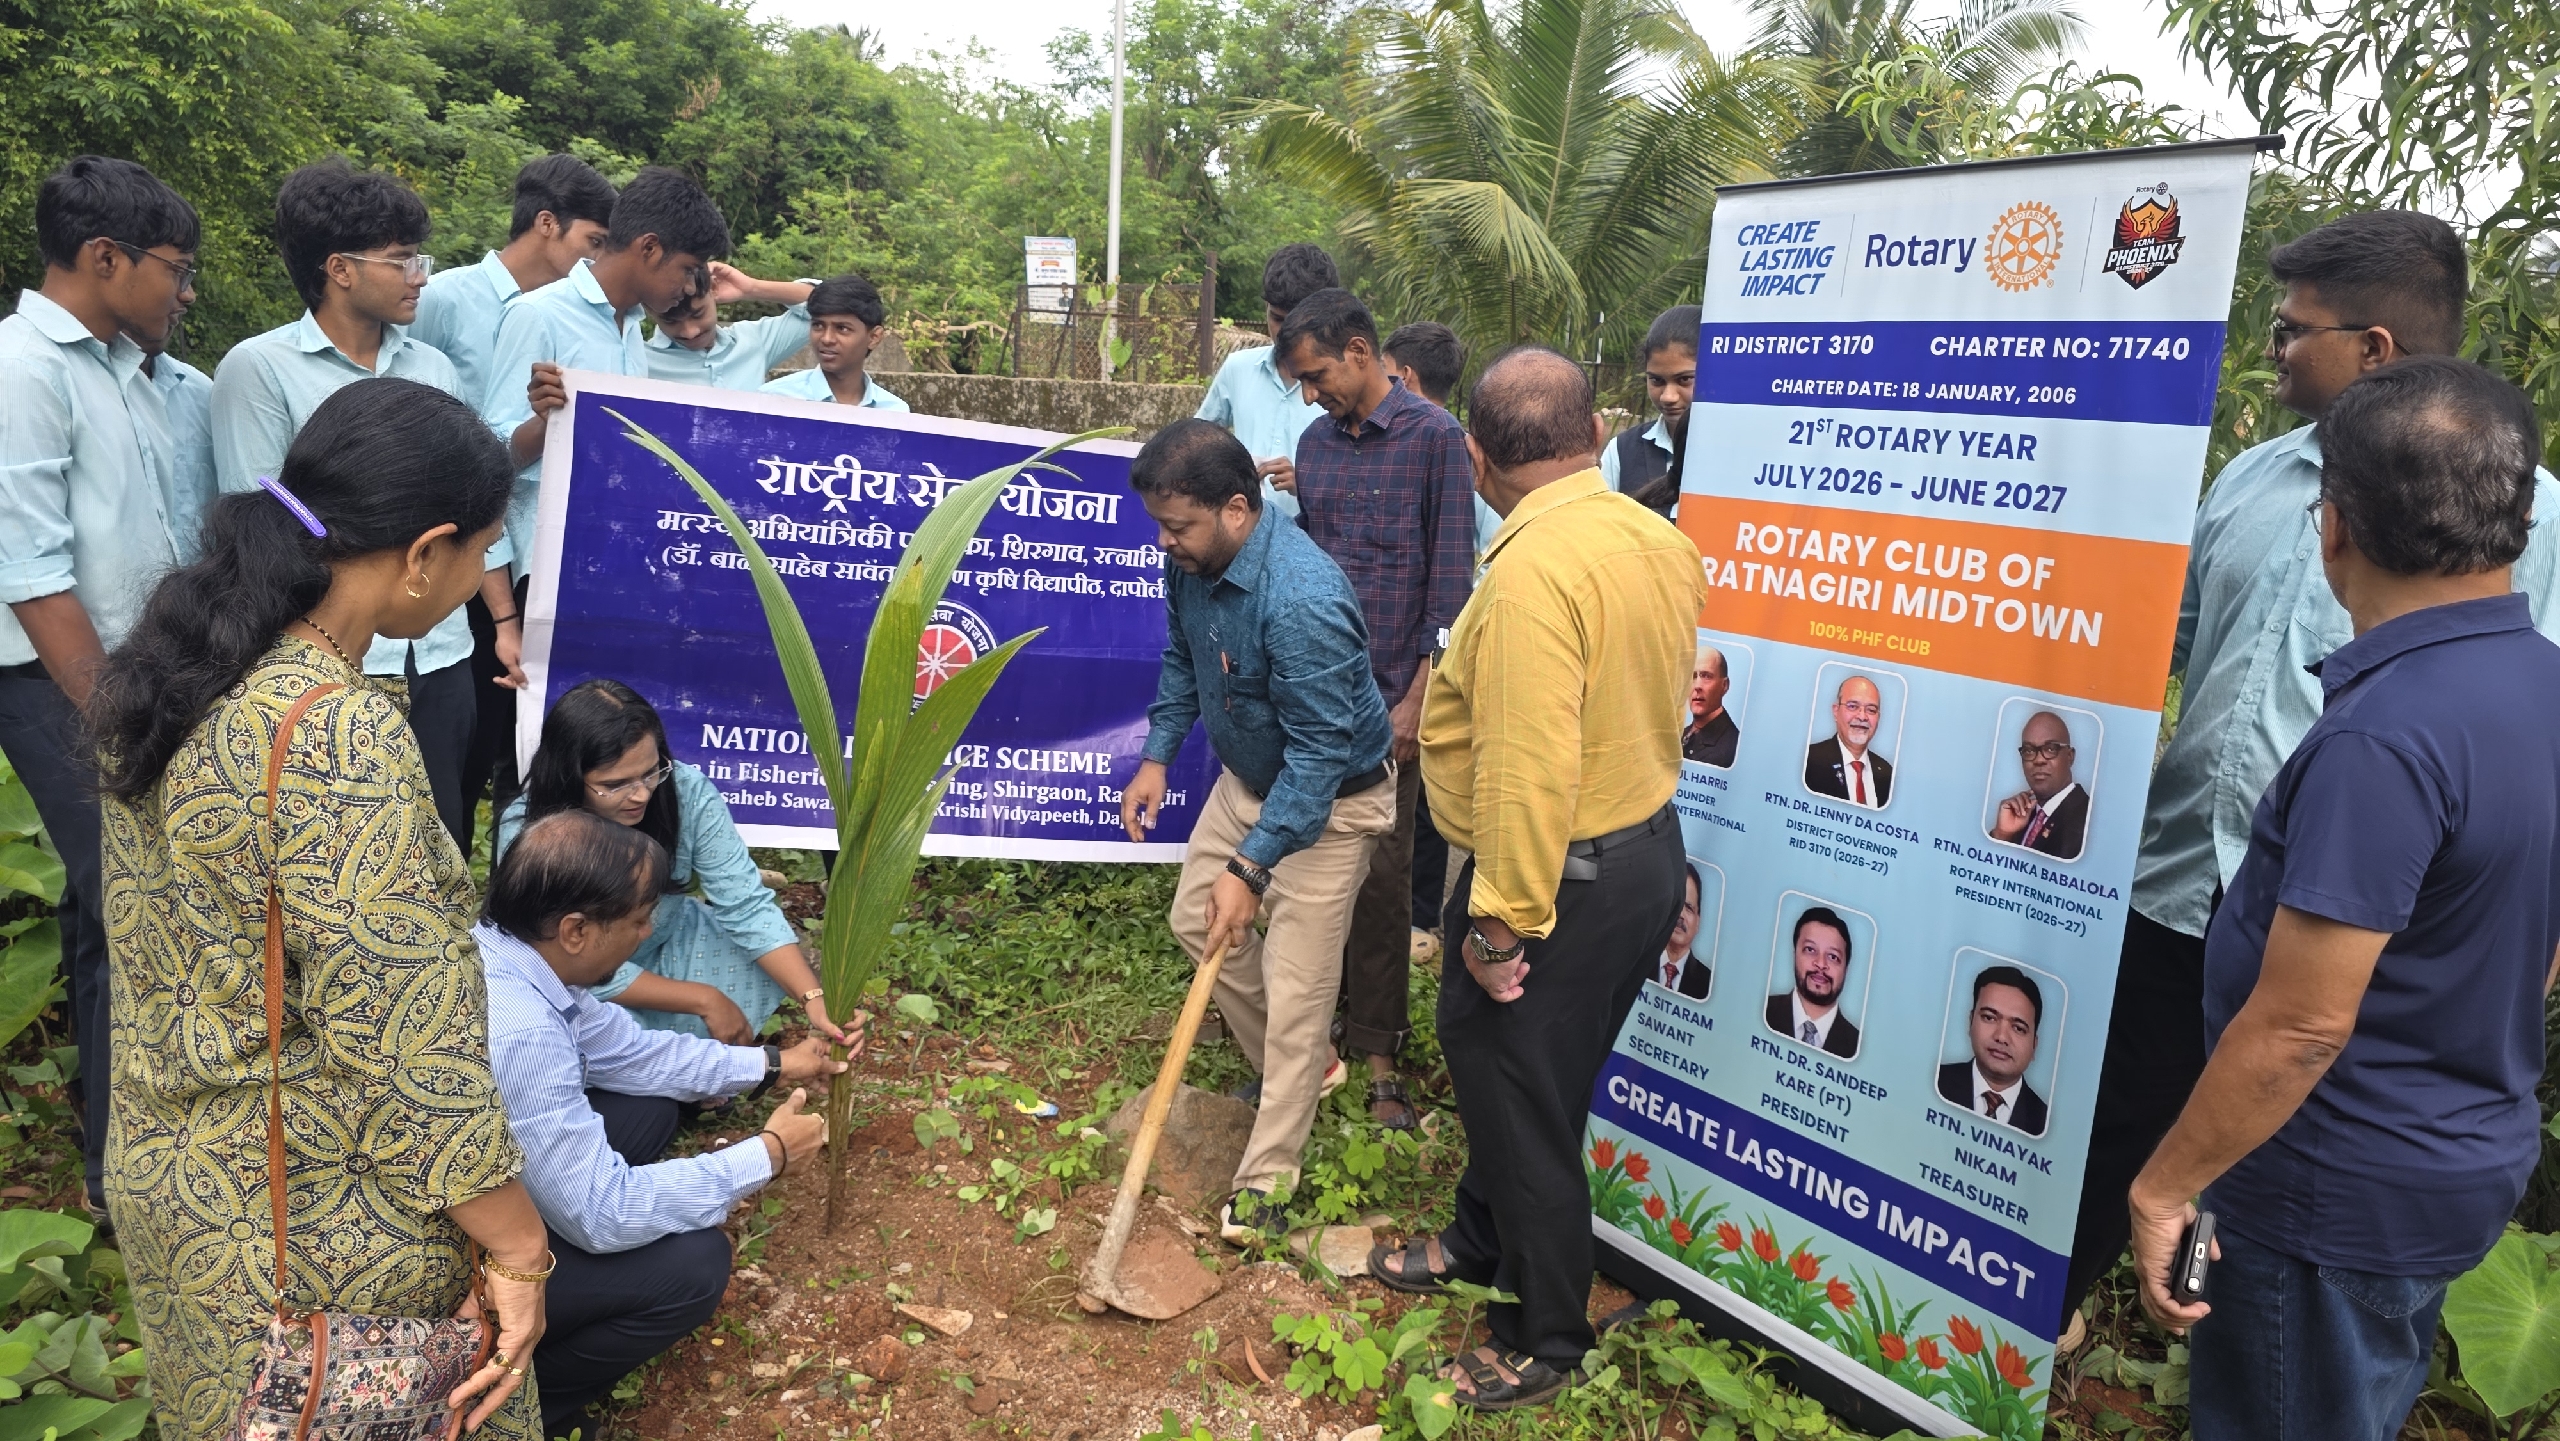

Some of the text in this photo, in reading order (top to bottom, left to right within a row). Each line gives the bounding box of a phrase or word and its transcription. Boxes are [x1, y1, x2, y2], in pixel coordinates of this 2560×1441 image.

[1738, 221, 1820, 246] CREATE
[2011, 210, 2044, 223] ROTARY
[1740, 246, 1836, 271] LASTING
[1865, 234, 1976, 273] Rotary
[2107, 243, 2178, 267] PHOENIX
[2133, 238, 2155, 247] TEAM
[1741, 273, 1825, 296] IMPACT
[1995, 260, 2048, 282] INTERNATIONAL
[1711, 335, 1874, 354] RI DISTRICT 3170
[1930, 336, 2190, 360] CHARTER NO: 71740
[1771, 379, 2077, 405] CHARTER DATE: 18 JANUARY, 2006
[1835, 424, 1952, 455] ROTARY
[1959, 431, 2038, 461] YEAR
[756, 454, 901, 513] राष्ट्रीय
[1000, 473, 1122, 524] योजना
[1754, 464, 1815, 490] JULY
[1817, 467, 1883, 495] 2026
[1911, 476, 1988, 507] JUNE
[1993, 481, 2068, 513] 2027
[746, 513, 895, 549] अभियांत्रिकी
[1002, 533, 1088, 567] शिरगाव,
[1094, 544, 1167, 569] रत्नागि
[1735, 522, 2055, 590] ROTARY CLUB OF
[662, 543, 702, 566] (डॉ.
[975, 568, 1021, 596] कृषि
[1023, 569, 1105, 598] विद्यापीठ,
[1702, 556, 2103, 647] RATNAGIRI MIDTOWN
[1809, 621, 1931, 656] 100% PHF CLUB
[996, 747, 1112, 774] SCHEME
[707, 760, 731, 779] in
[994, 781, 1091, 804] Shirgaon,
[1676, 789, 1716, 807] OUNDER
[1691, 772, 1728, 791] HARRIS
[721, 790, 777, 808] saheb
[781, 792, 834, 810] Sawa
[934, 802, 987, 819] Krishi
[992, 805, 1094, 825] Vidyapeeth,
[1674, 804, 1746, 833] NTERNATIONAL
[1764, 791, 1919, 844] RTN. DR. LENNY DA COSTA
[1786, 818, 1898, 859] DISTRICT GOVERNOR
[1789, 836, 1889, 876] RID 3170 (2026-27)
[1933, 838, 2119, 901] RTN. OLAYINKA BABALOLA
[1949, 865, 2103, 920] ROTARY INTERNATIONAL
[1955, 886, 2087, 938] PRESIDENT (2026-27)
[1637, 1012, 1695, 1047] SAWANT
[1653, 996, 1713, 1031] SITARAM
[1629, 1035, 1709, 1081] SECRETARY
[1750, 1036, 1888, 1102] RTN. DR. SANDEEP
[1776, 1070, 1852, 1117] KARE (PT)
[1761, 1093, 1850, 1144] PRESIDENT
[1926, 1107, 2053, 1176] RTN. VINAYAK
[1954, 1147, 2018, 1186] NIKAM
[1607, 1075, 2036, 1299] CREATE LASTING IMPACT
[1919, 1162, 2029, 1226] TREASURER
